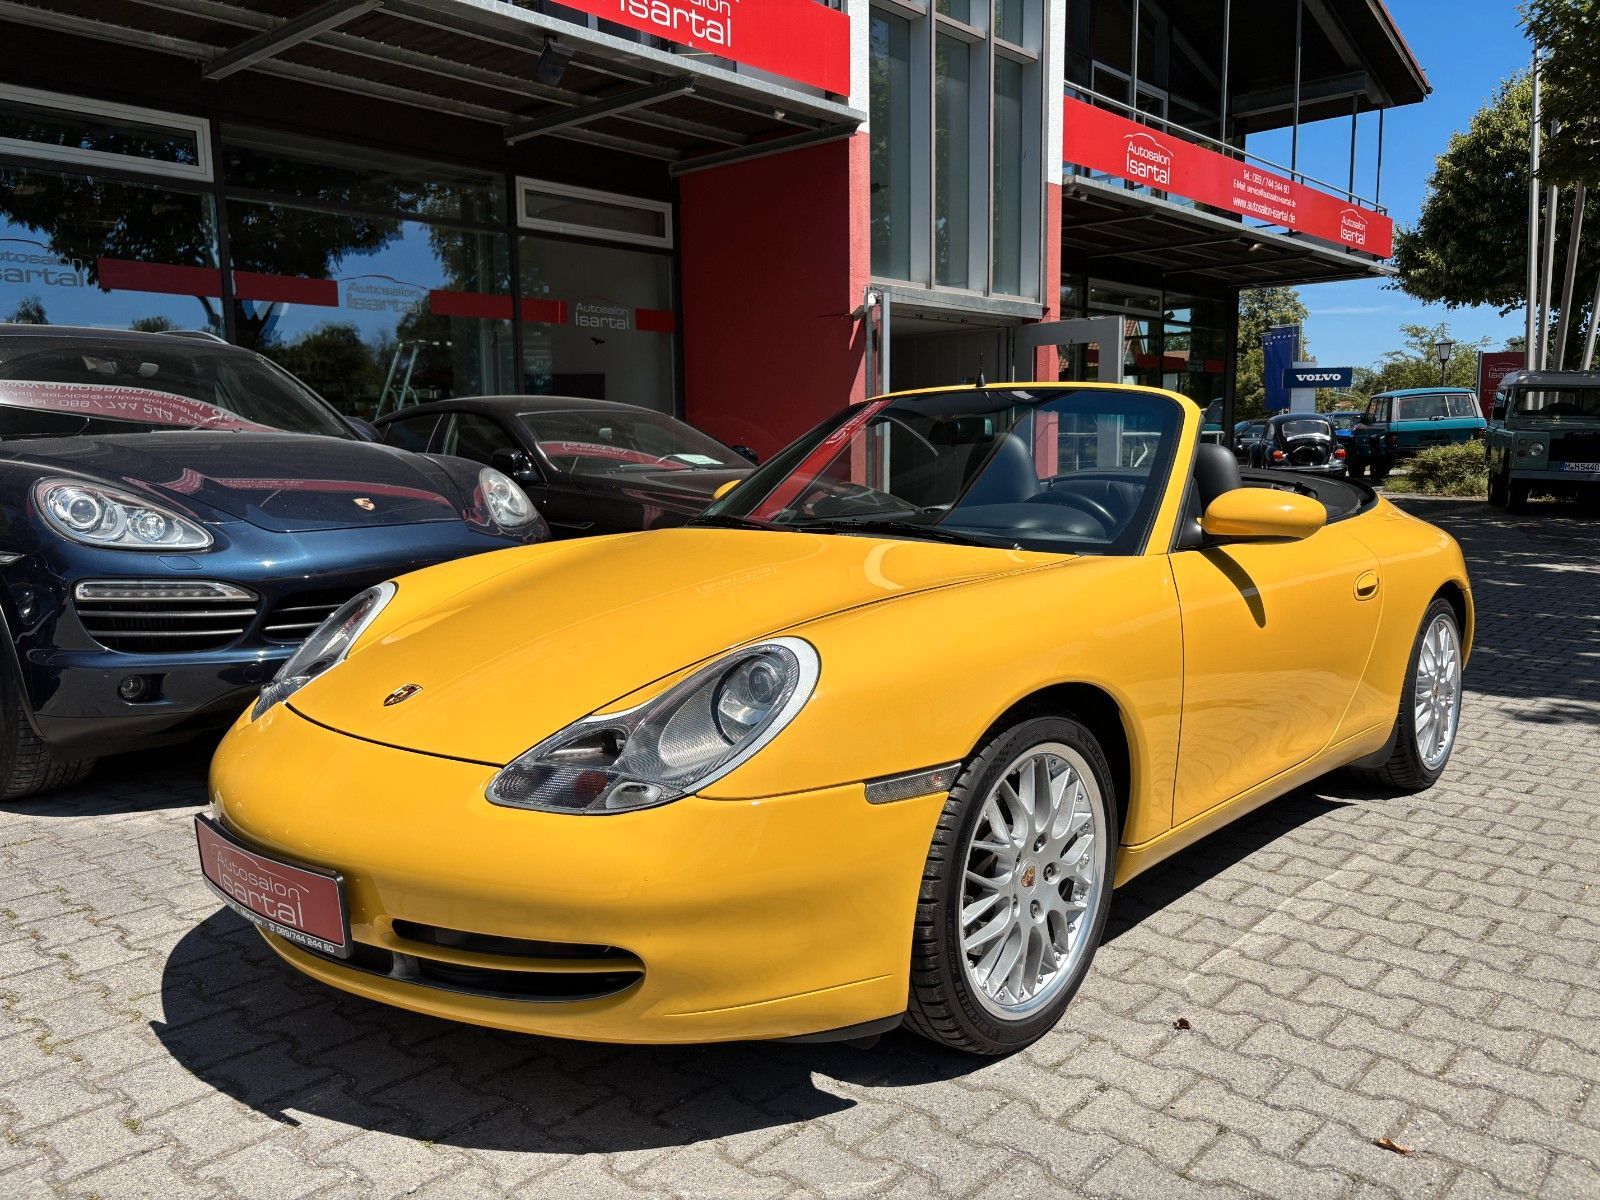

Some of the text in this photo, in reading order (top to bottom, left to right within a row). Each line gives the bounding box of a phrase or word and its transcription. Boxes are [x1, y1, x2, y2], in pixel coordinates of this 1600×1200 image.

[1127, 141, 1171, 167] Autosalon
[1126, 153, 1171, 185] Isartal
[1265, 178, 1274, 189] 744
[1274, 181, 1283, 192] 244
[1233, 196, 1296, 224] www.autosalon-isartal.de
[1341, 215, 1366, 231] Autosalon
[1340, 224, 1366, 245] Isartal
[347, 281, 422, 298] Autosalon
[347, 291, 422, 314] Isartal
[575, 302, 629, 316] Autosalon
[575, 312, 629, 330] Isartal
[1296, 373, 1342, 382] VOLVO
[217, 850, 301, 902] Autosalon
[217, 863, 304, 928] Isartal
[307, 937, 323, 949] 244
